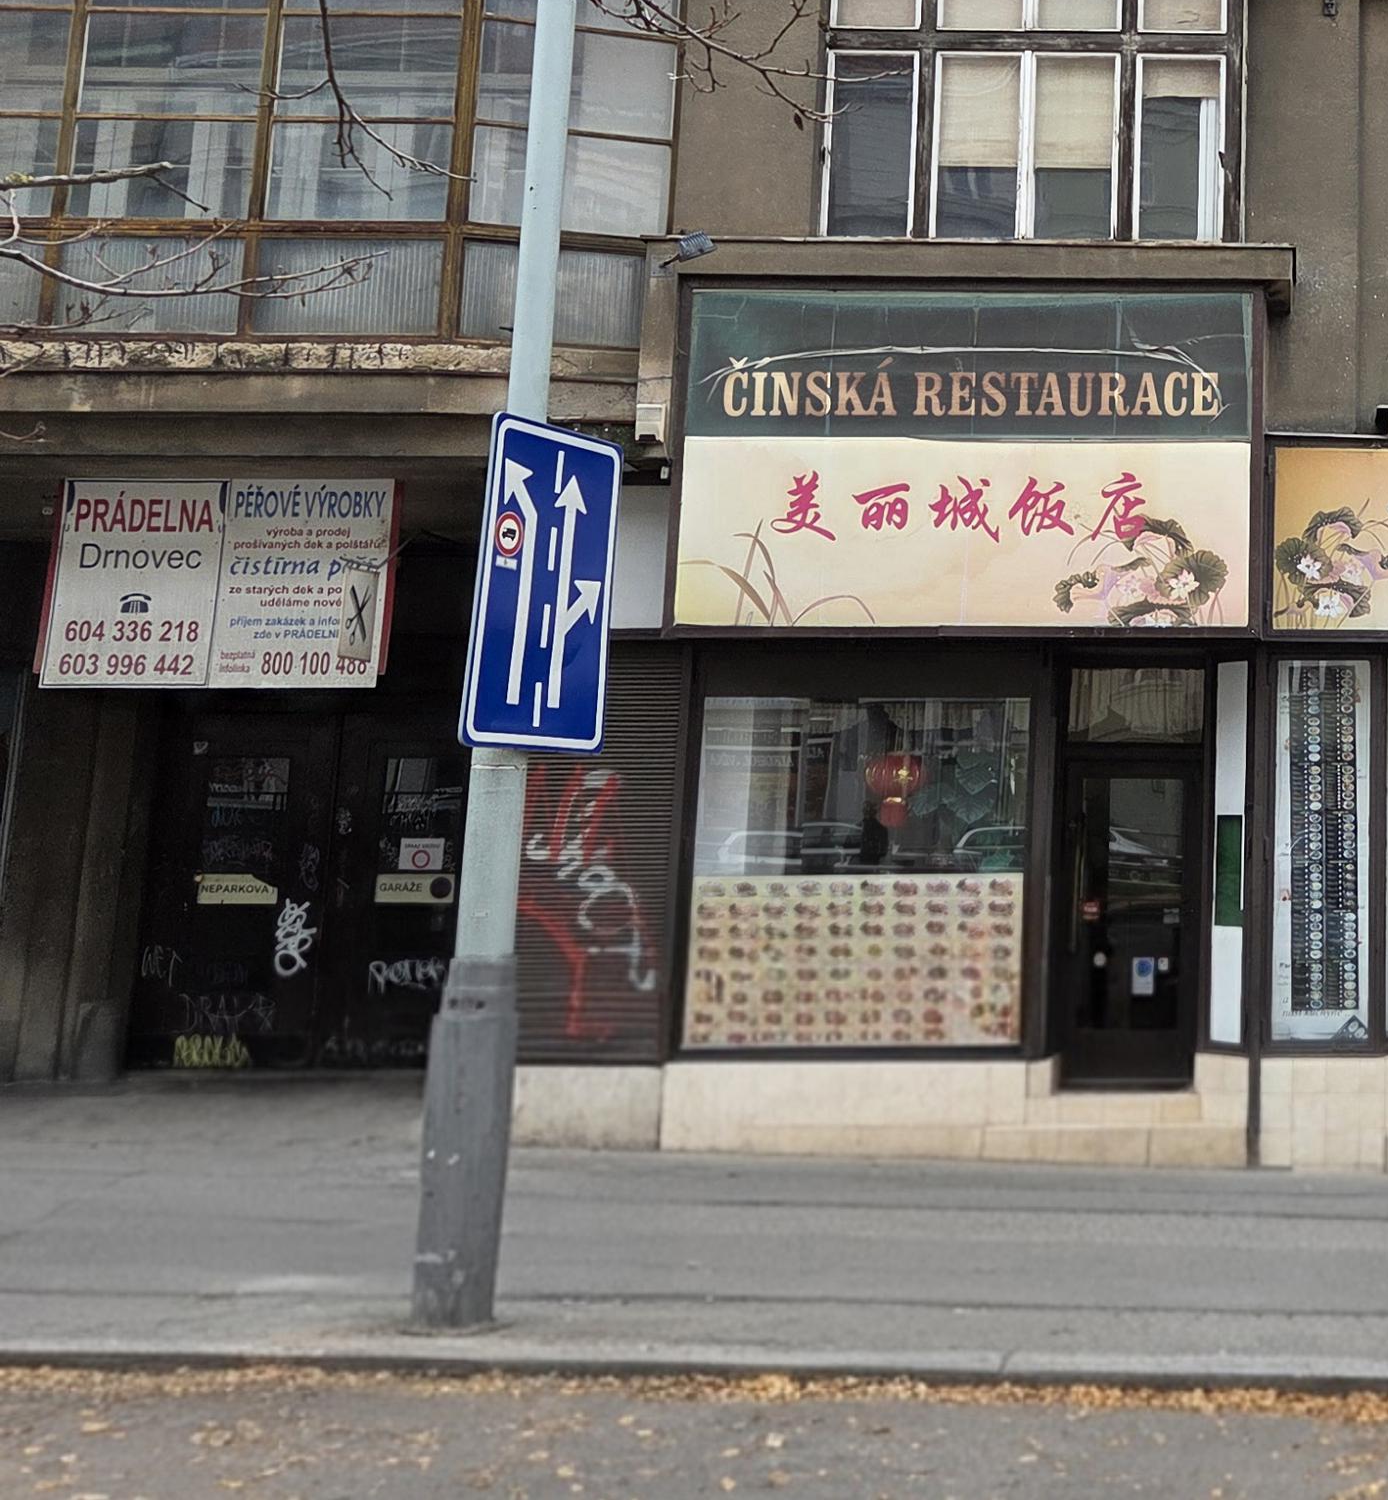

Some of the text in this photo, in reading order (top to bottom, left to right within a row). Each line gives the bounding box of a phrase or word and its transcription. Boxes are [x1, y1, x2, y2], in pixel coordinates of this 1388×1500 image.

[722, 355, 1221, 418] ČINSKÁ RESTAURACE
[234, 484, 387, 518] PÉŘOVÉ VÝROBKY
[770, 469, 1148, 542] 美丽城饭店
[74, 490, 214, 533] PRÁDELNA
[266, 527, 303, 539] výroba
[315, 526, 351, 538] prodej
[233, 538, 300, 550] prošívaných
[303, 538, 323, 549] dek
[326, 541, 333, 549] a
[79, 543, 202, 569] Drnovec
[230, 556, 319, 576] čistírna
[229, 586, 242, 594] ze
[245, 584, 290, 596] starých
[292, 585, 313, 594] dek
[317, 586, 324, 594] a
[260, 597, 342, 607] uděláme nové
[64, 620, 199, 642] 604 336 218
[229, 616, 262, 628] příjem
[265, 616, 306, 626] zakázek
[253, 630, 272, 639] zde
[283, 628, 339, 639] PRÁDELN
[59, 653, 194, 675] 603 996 442
[261, 651, 293, 675] 800
[300, 651, 331, 675] 100
[201, 883, 275, 894] NEPARKOVA
[379, 881, 423, 892] GARÁŽE
